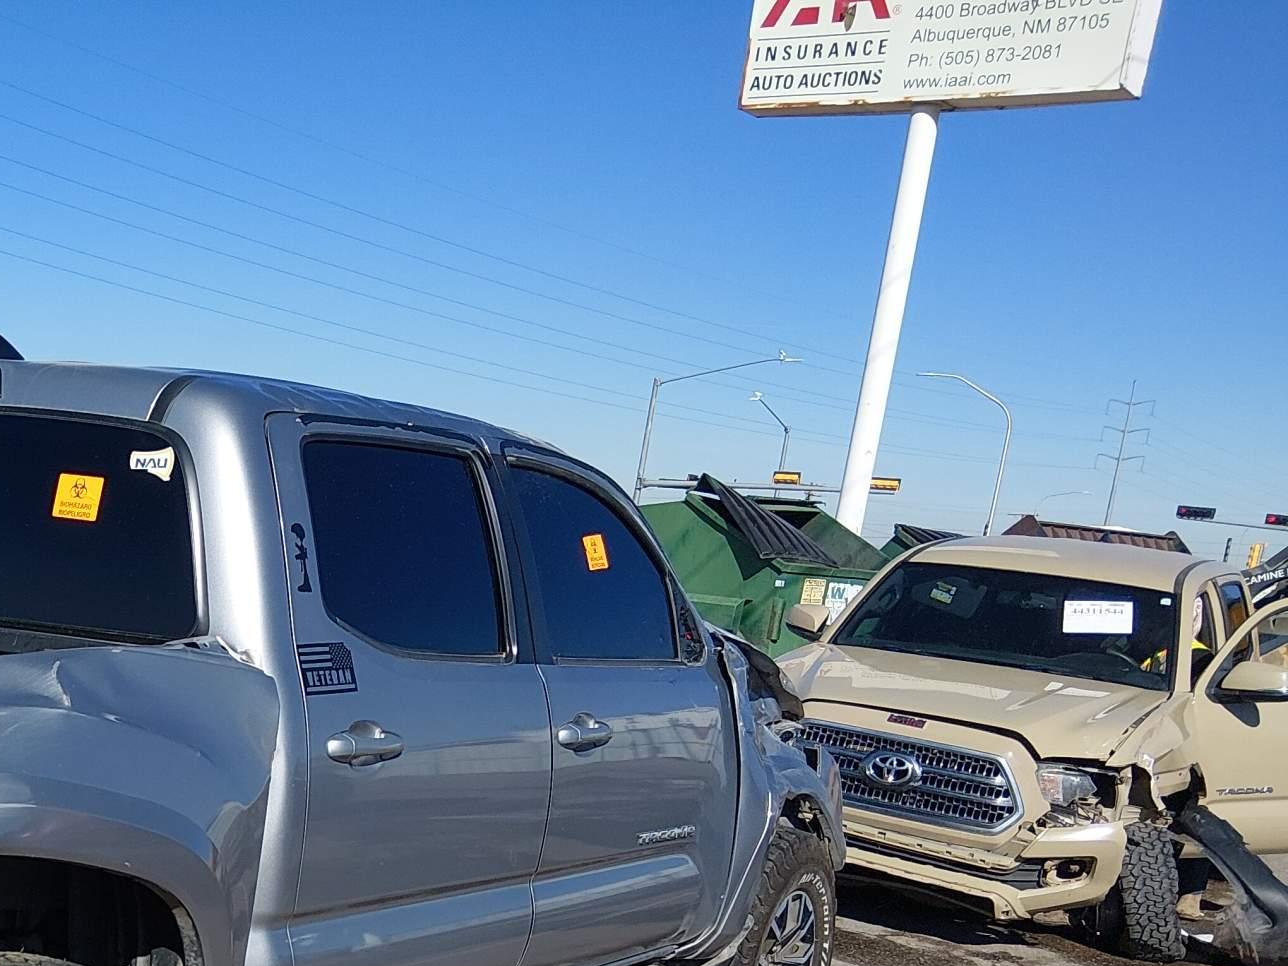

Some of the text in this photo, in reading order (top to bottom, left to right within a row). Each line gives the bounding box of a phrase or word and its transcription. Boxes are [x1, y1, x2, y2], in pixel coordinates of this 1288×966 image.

[915, 4, 954, 21] 4400
[959, 0, 1040, 18] Broadway
[911, 13, 1110, 44] Albuquerque, NM 87105
[755, 39, 888, 62] INSURANCE
[908, 44, 1062, 69] Ph: (505) 873-2081
[750, 69, 883, 91] AUTO AUCTIONS
[903, 72, 1012, 89] www.iaai.com
[135, 457, 168, 469] NAU
[306, 667, 353, 686] VETERAN
